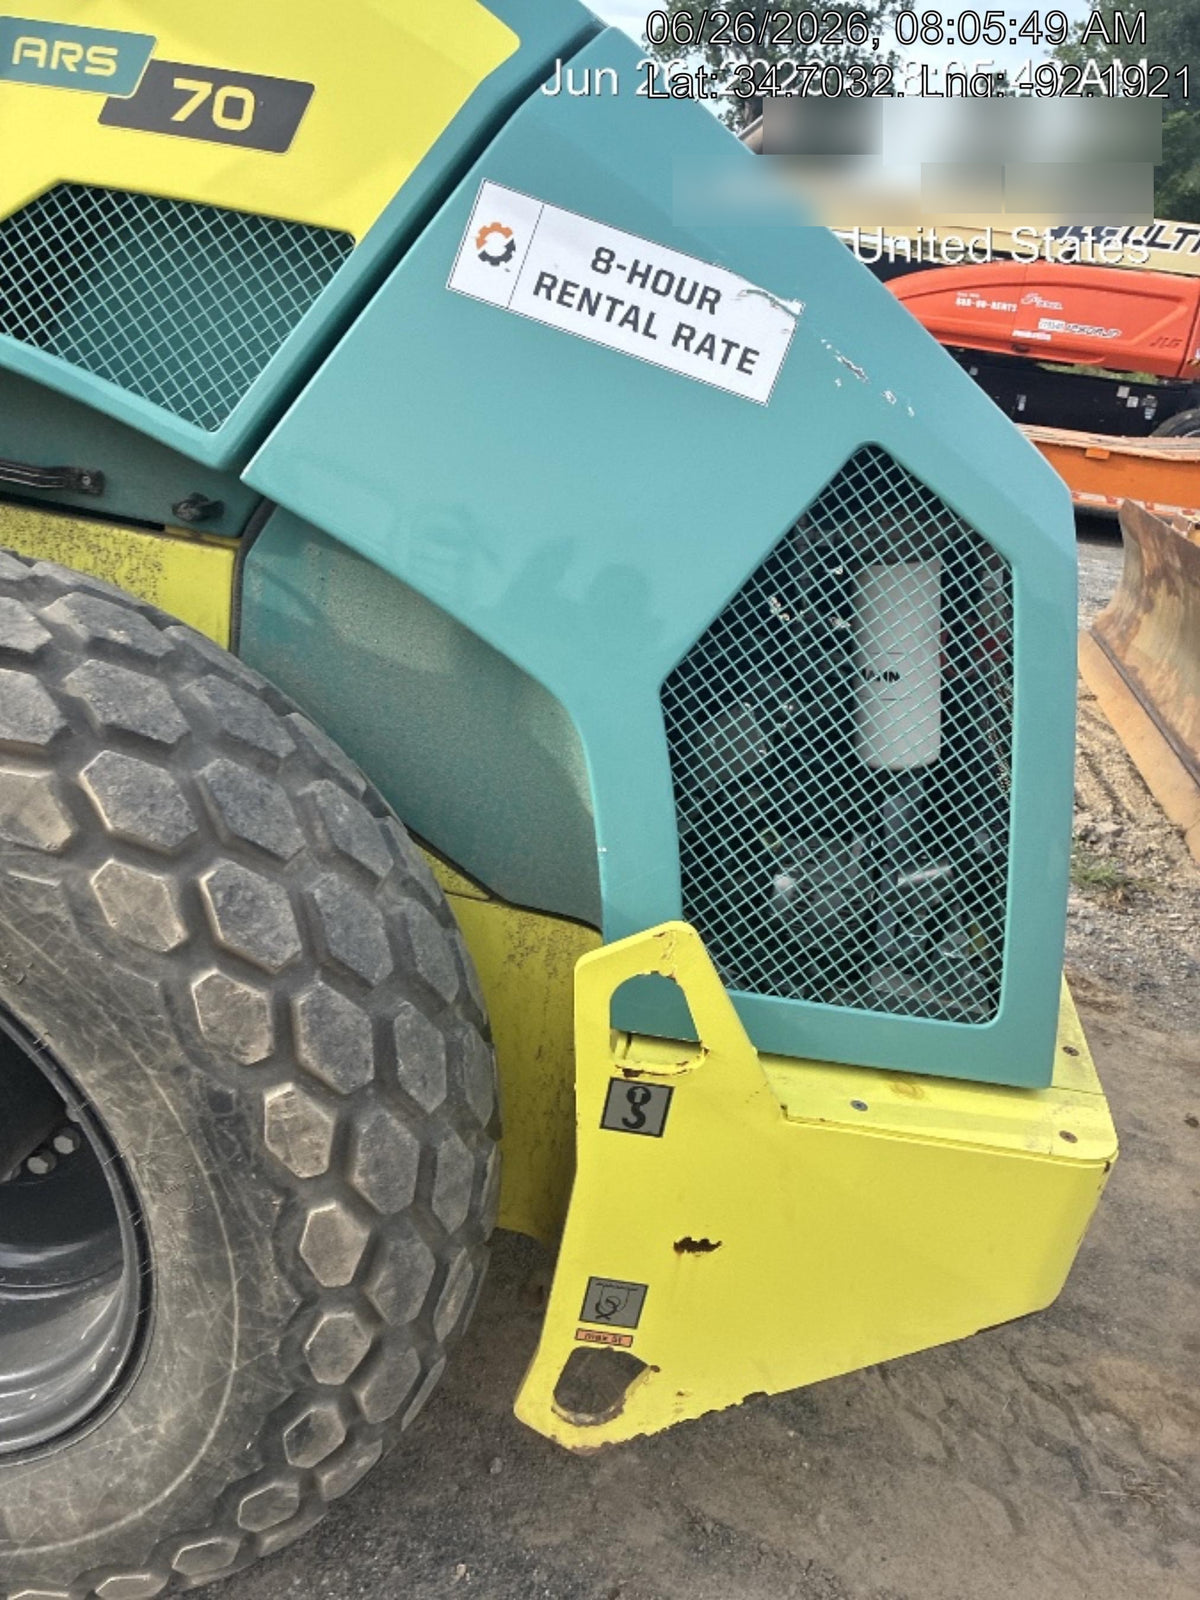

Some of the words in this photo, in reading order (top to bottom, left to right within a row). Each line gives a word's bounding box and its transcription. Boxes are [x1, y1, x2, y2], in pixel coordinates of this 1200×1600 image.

[12, 36, 119, 77] ARS
[170, 77, 255, 131] 70
[590, 246, 722, 316] 8-HOUR
[532, 271, 658, 340] RENTAL
[671, 322, 760, 376] RATE
